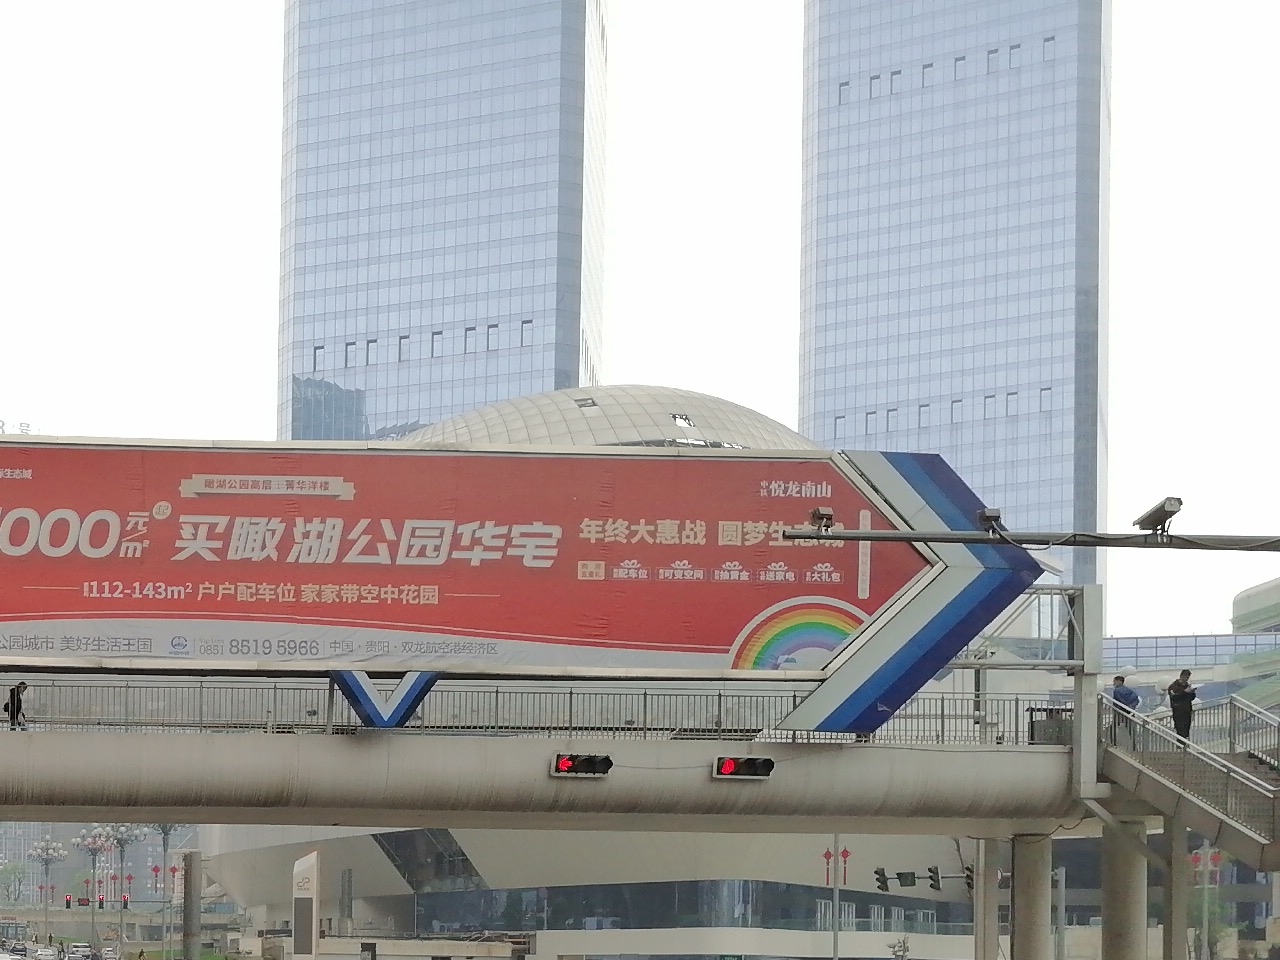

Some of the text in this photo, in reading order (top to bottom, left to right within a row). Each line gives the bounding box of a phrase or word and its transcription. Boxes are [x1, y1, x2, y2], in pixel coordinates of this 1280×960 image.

[769, 480, 832, 498] 悦龙南山
[170, 515, 563, 569] 买瞰湖公园华宅
[579, 518, 707, 546] 年终大惠战
[196, 582, 297, 602] 户户配车位
[300, 583, 440, 605] 家家带空中花园
[59, 634, 153, 654] 美好生活王国
[228, 638, 273, 656] 8519
[275, 639, 320, 657] 5966
